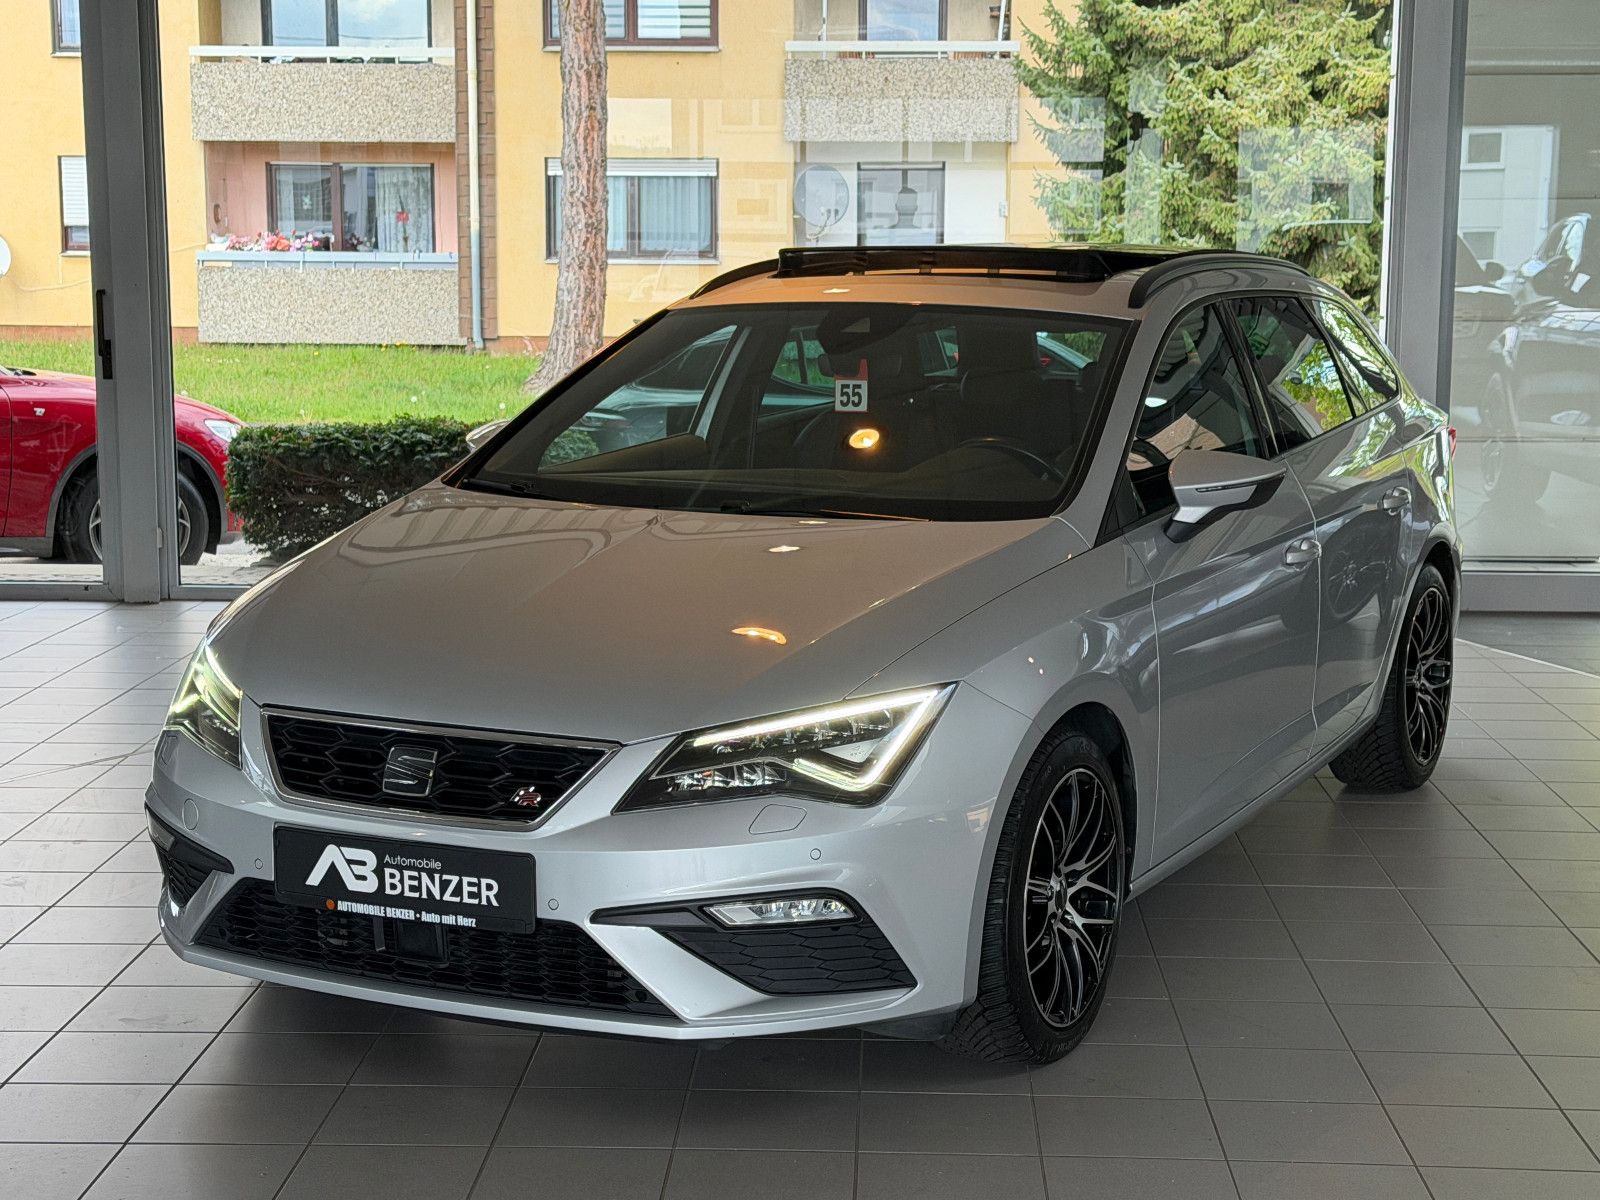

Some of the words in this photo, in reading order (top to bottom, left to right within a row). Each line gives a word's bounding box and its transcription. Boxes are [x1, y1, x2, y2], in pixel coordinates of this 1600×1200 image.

[839, 383, 862, 407] 55
[305, 844, 378, 893] AB
[384, 854, 442, 870] Automobile
[384, 867, 499, 907] BENZER
[337, 900, 385, 916] AUTOMOBILE
[386, 906, 415, 920] BENZER
[421, 911, 440, 924] Auto
[441, 913, 456, 926] mit
[457, 915, 477, 928] Herz
